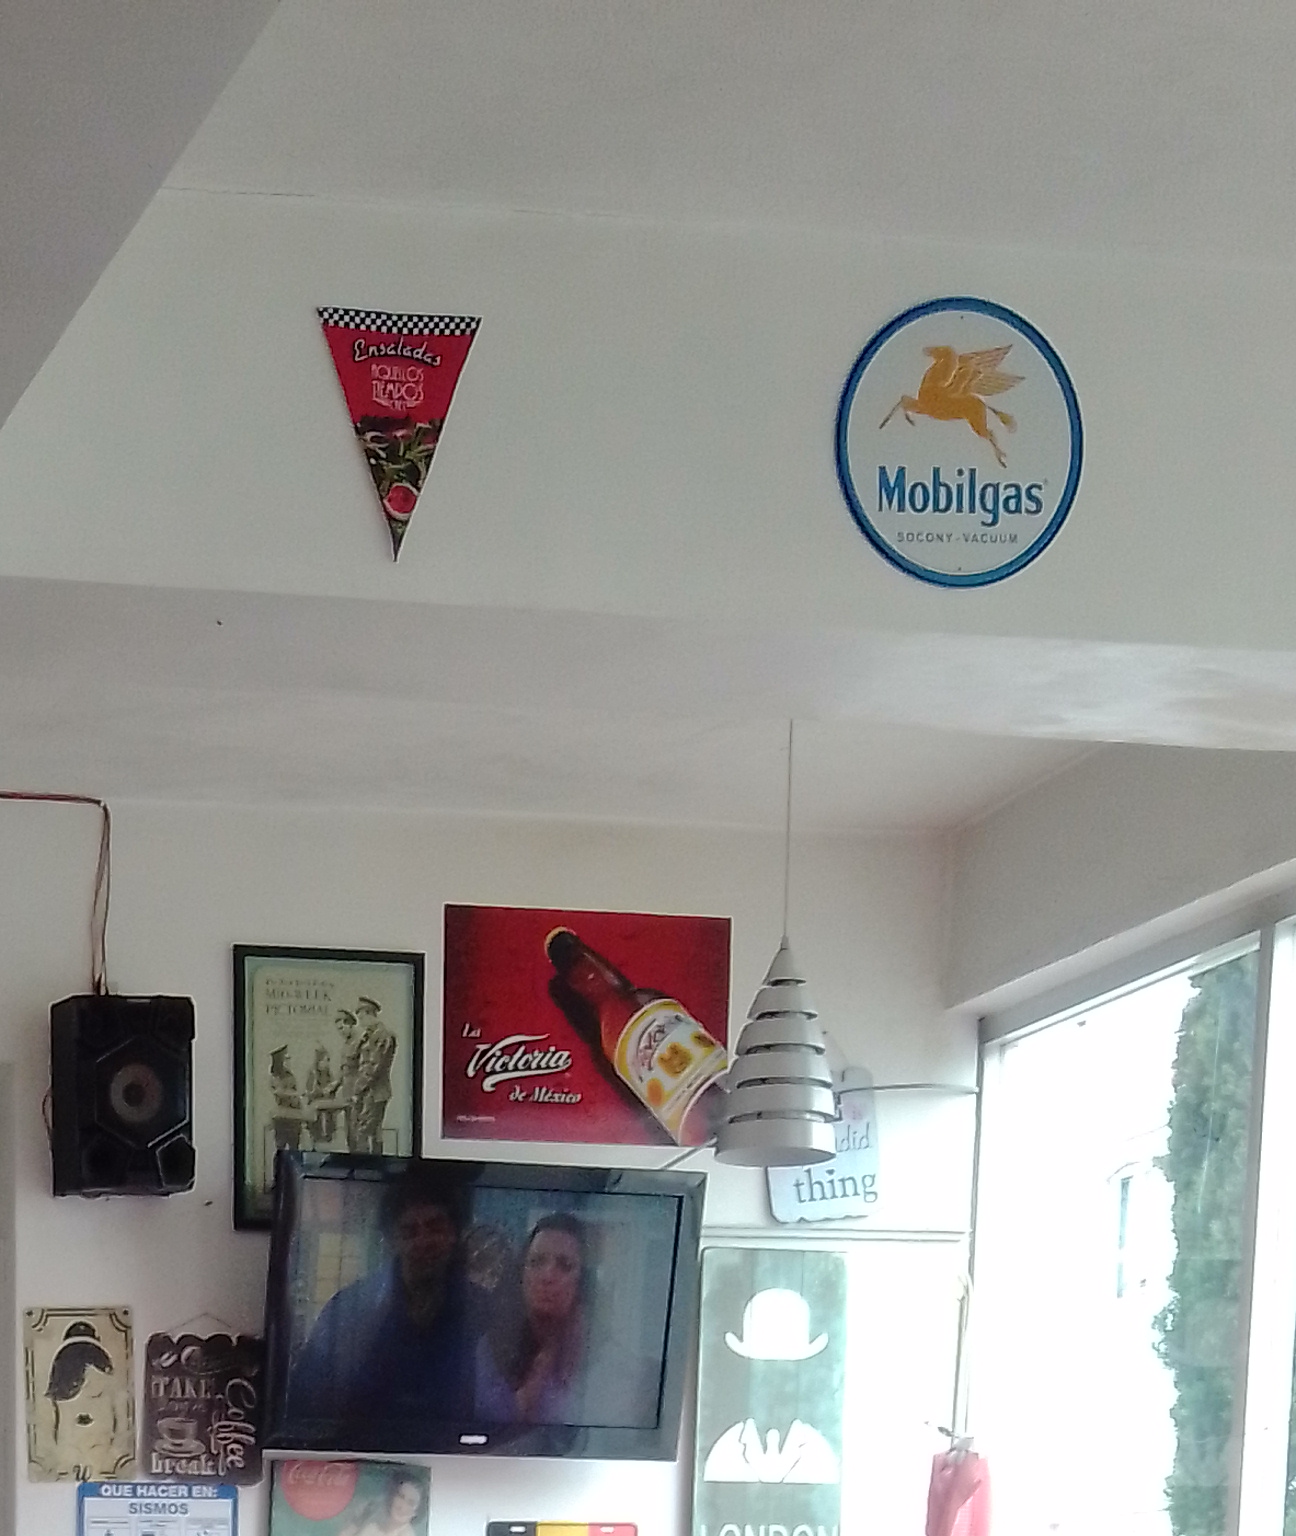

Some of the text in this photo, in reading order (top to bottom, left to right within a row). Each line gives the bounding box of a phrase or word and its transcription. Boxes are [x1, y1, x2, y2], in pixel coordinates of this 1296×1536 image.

[354, 336, 442, 366] Ensaladas
[877, 465, 1044, 527] Mobilgas
[461, 1022, 482, 1039] La
[466, 1034, 573, 1091] Victoria
[508, 1085, 582, 1104] de México
[792, 1168, 878, 1203] thing
[216, 1378, 257, 1468] Coffee
[151, 1451, 217, 1476] break
[100, 1485, 218, 1498] QUE HACER EN:
[128, 1502, 189, 1516] SISMOS
